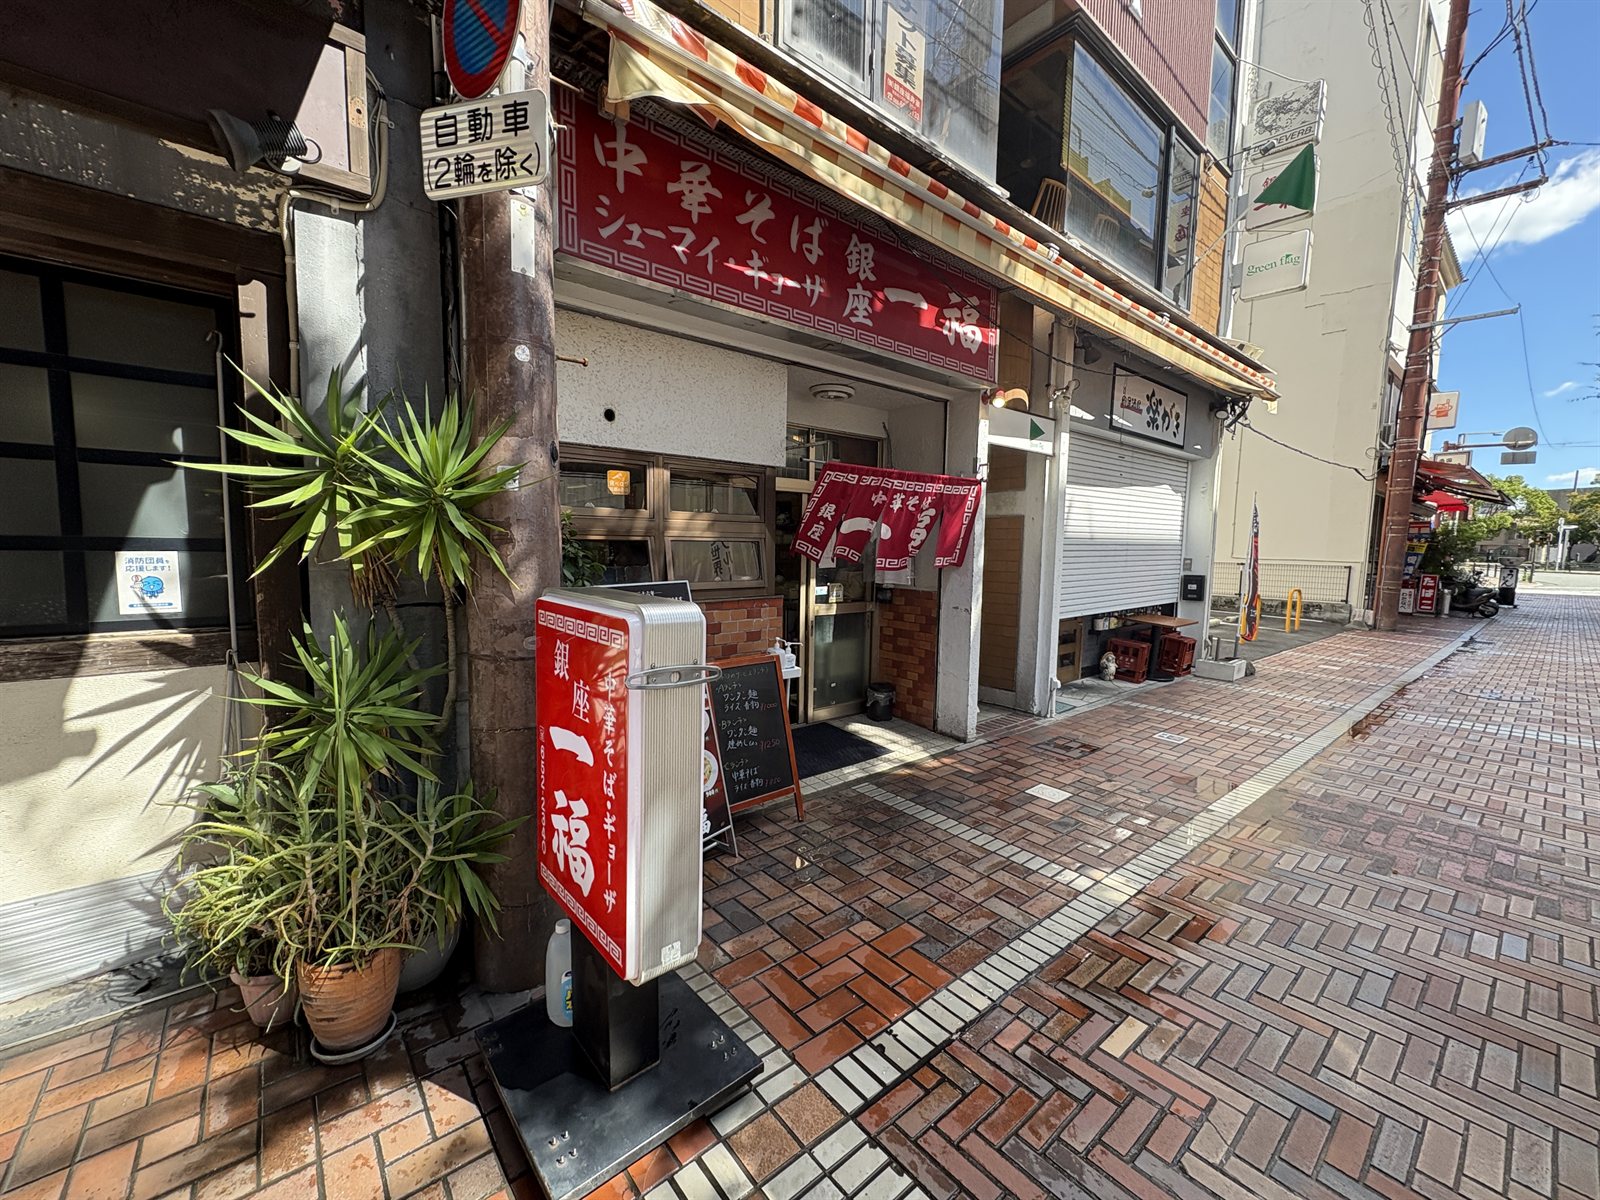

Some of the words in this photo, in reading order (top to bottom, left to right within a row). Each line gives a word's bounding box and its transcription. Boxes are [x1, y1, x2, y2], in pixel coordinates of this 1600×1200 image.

[435, 100, 529, 148] 自動車
[427, 142, 541, 191] (2輪を除く)
[593, 119, 829, 265] 中華そば
[594, 195, 828, 307] シューマイ・ギョーザ
[1246, 261, 1278, 277] green
[1279, 253, 1301, 267] flag
[843, 233, 878, 328] 銀座
[883, 287, 983, 355] 一福
[807, 502, 837, 542] 銀座
[871, 490, 936, 514] 中華そば
[1420, 577, 1436, 609] たばこ
[553, 639, 591, 724] 銀座
[549, 724, 596, 898] 一福
[602, 671, 618, 914] 中華そば・ギョーザ
